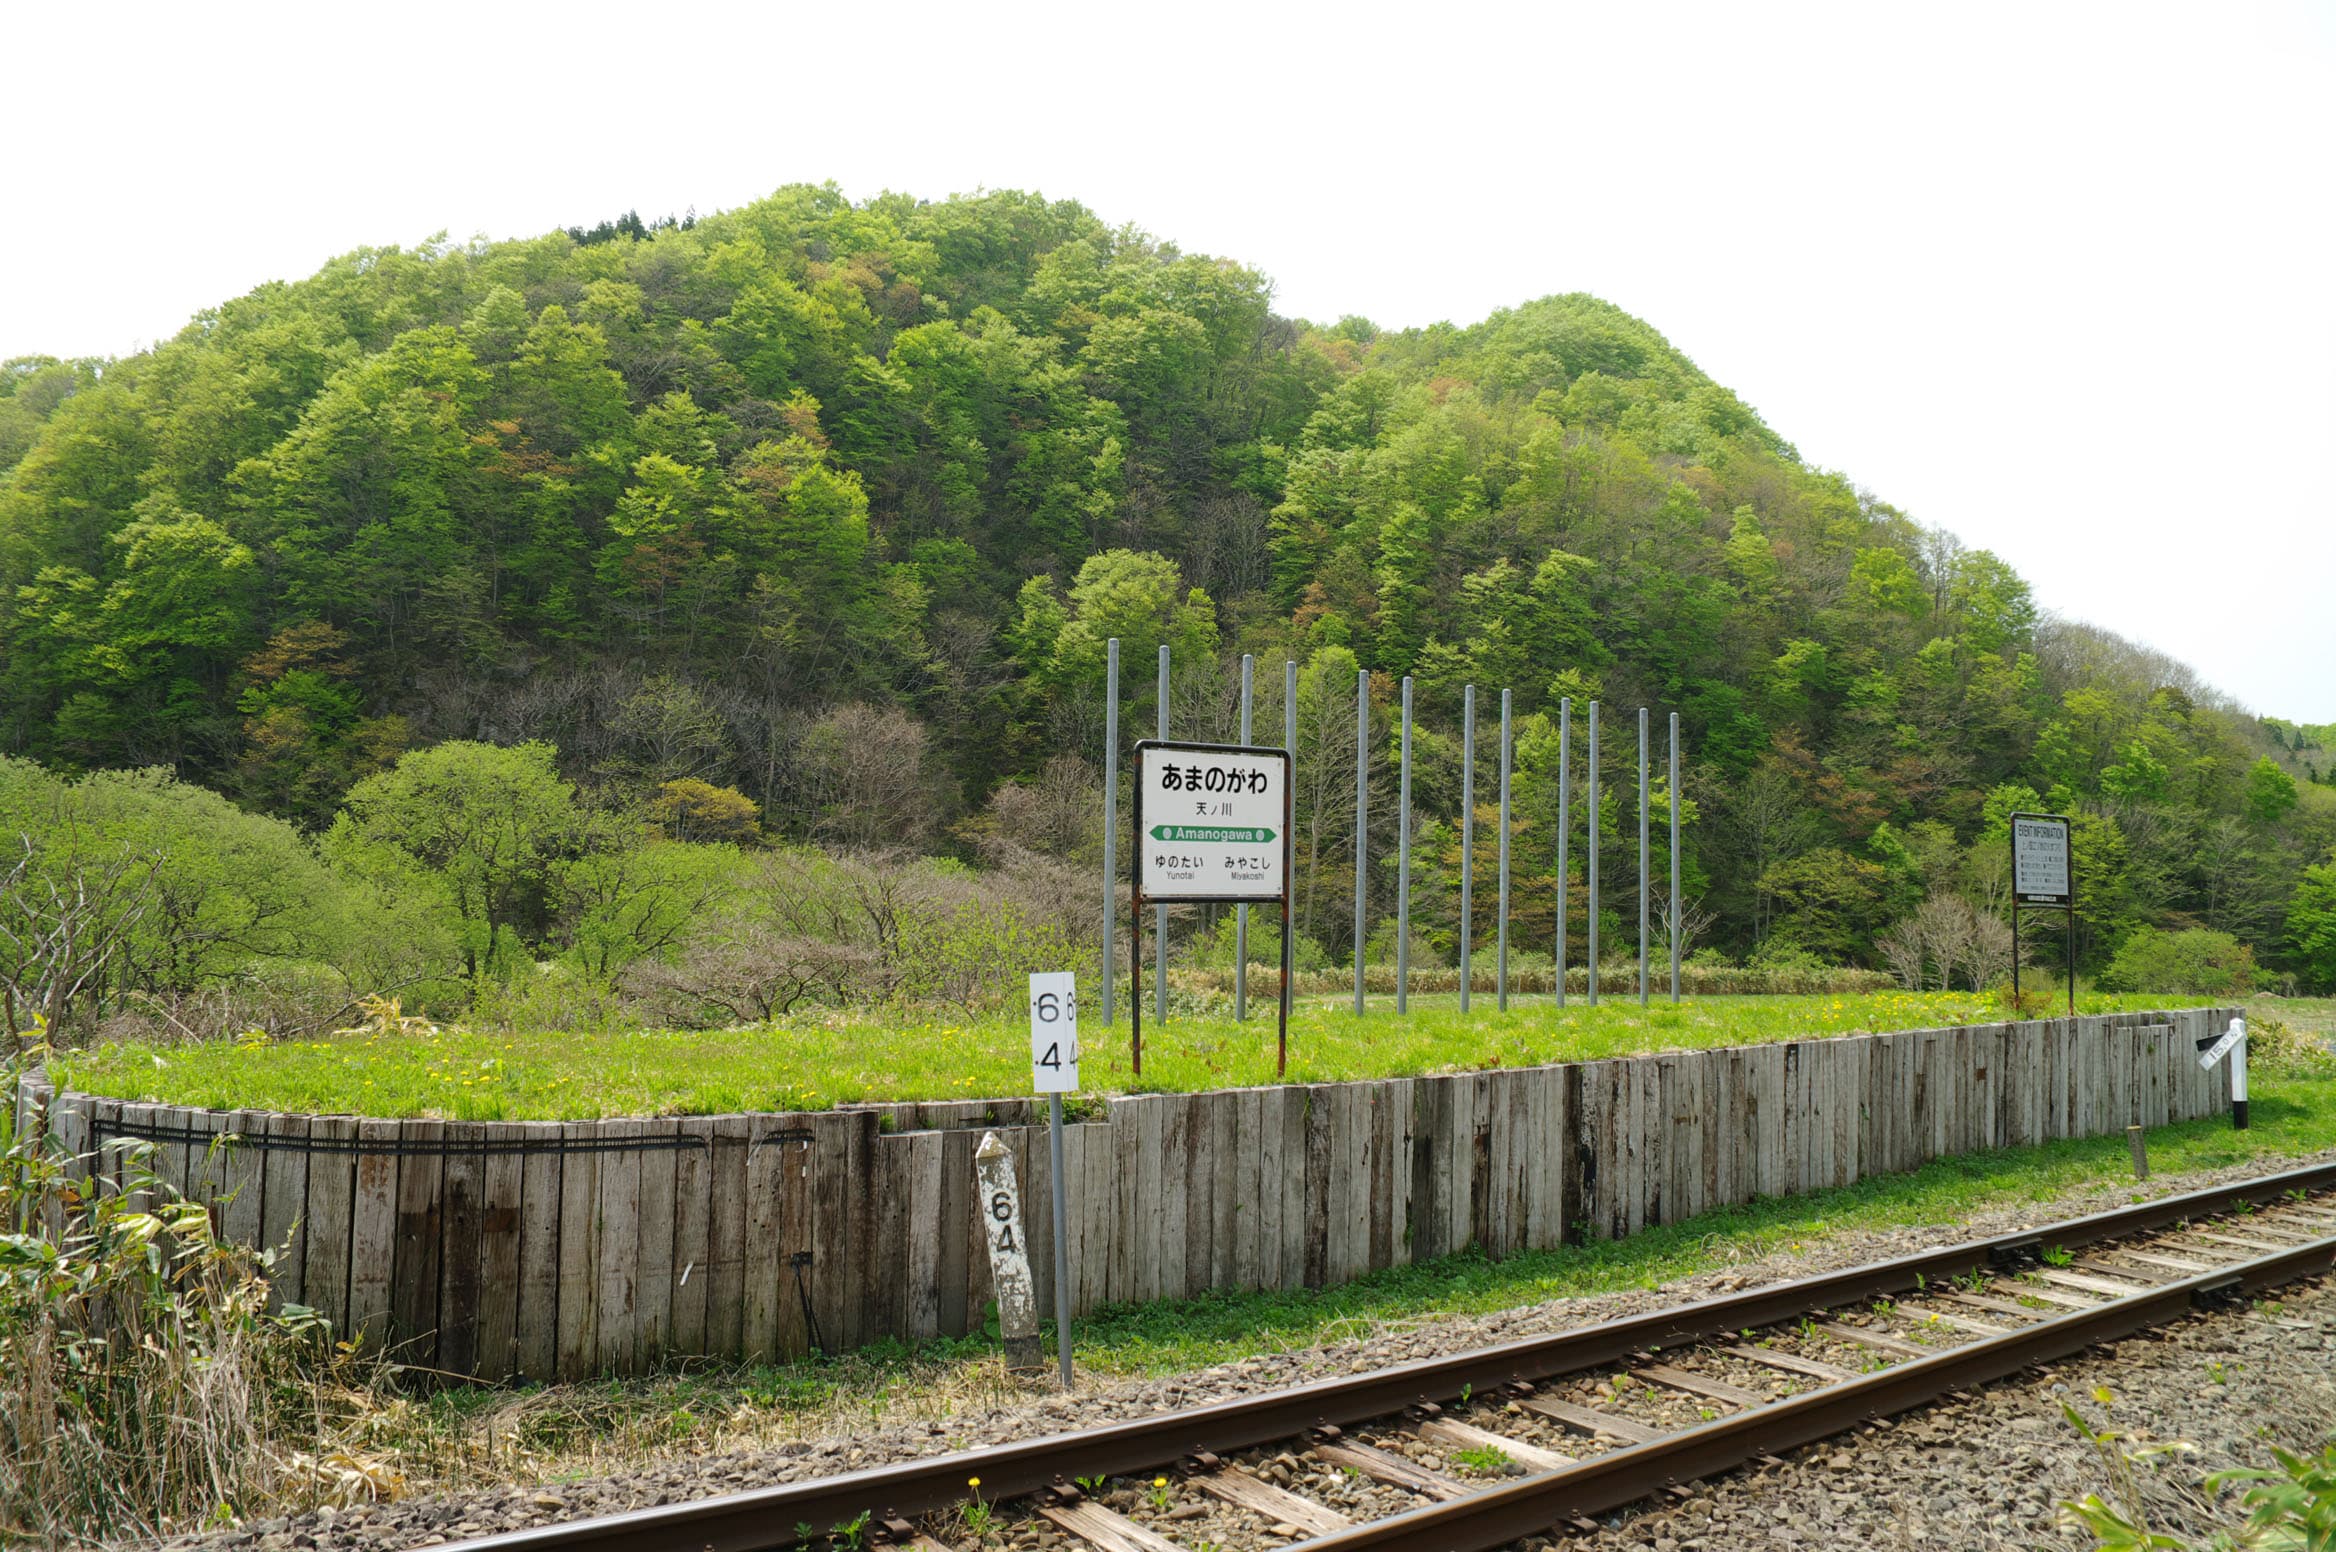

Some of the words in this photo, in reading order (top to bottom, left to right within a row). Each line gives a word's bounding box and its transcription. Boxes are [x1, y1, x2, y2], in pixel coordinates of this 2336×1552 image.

[1161, 763, 1268, 794] あまのがわ
[1195, 802, 1232, 816] 天ノ川
[1175, 827, 1252, 842] Amanogawa
[1155, 855, 1204, 868] ゆのたい
[1224, 856, 1271, 870] みやこし
[1166, 871, 1195, 880] Yunotai
[1231, 871, 1265, 881] Miyakoshi
